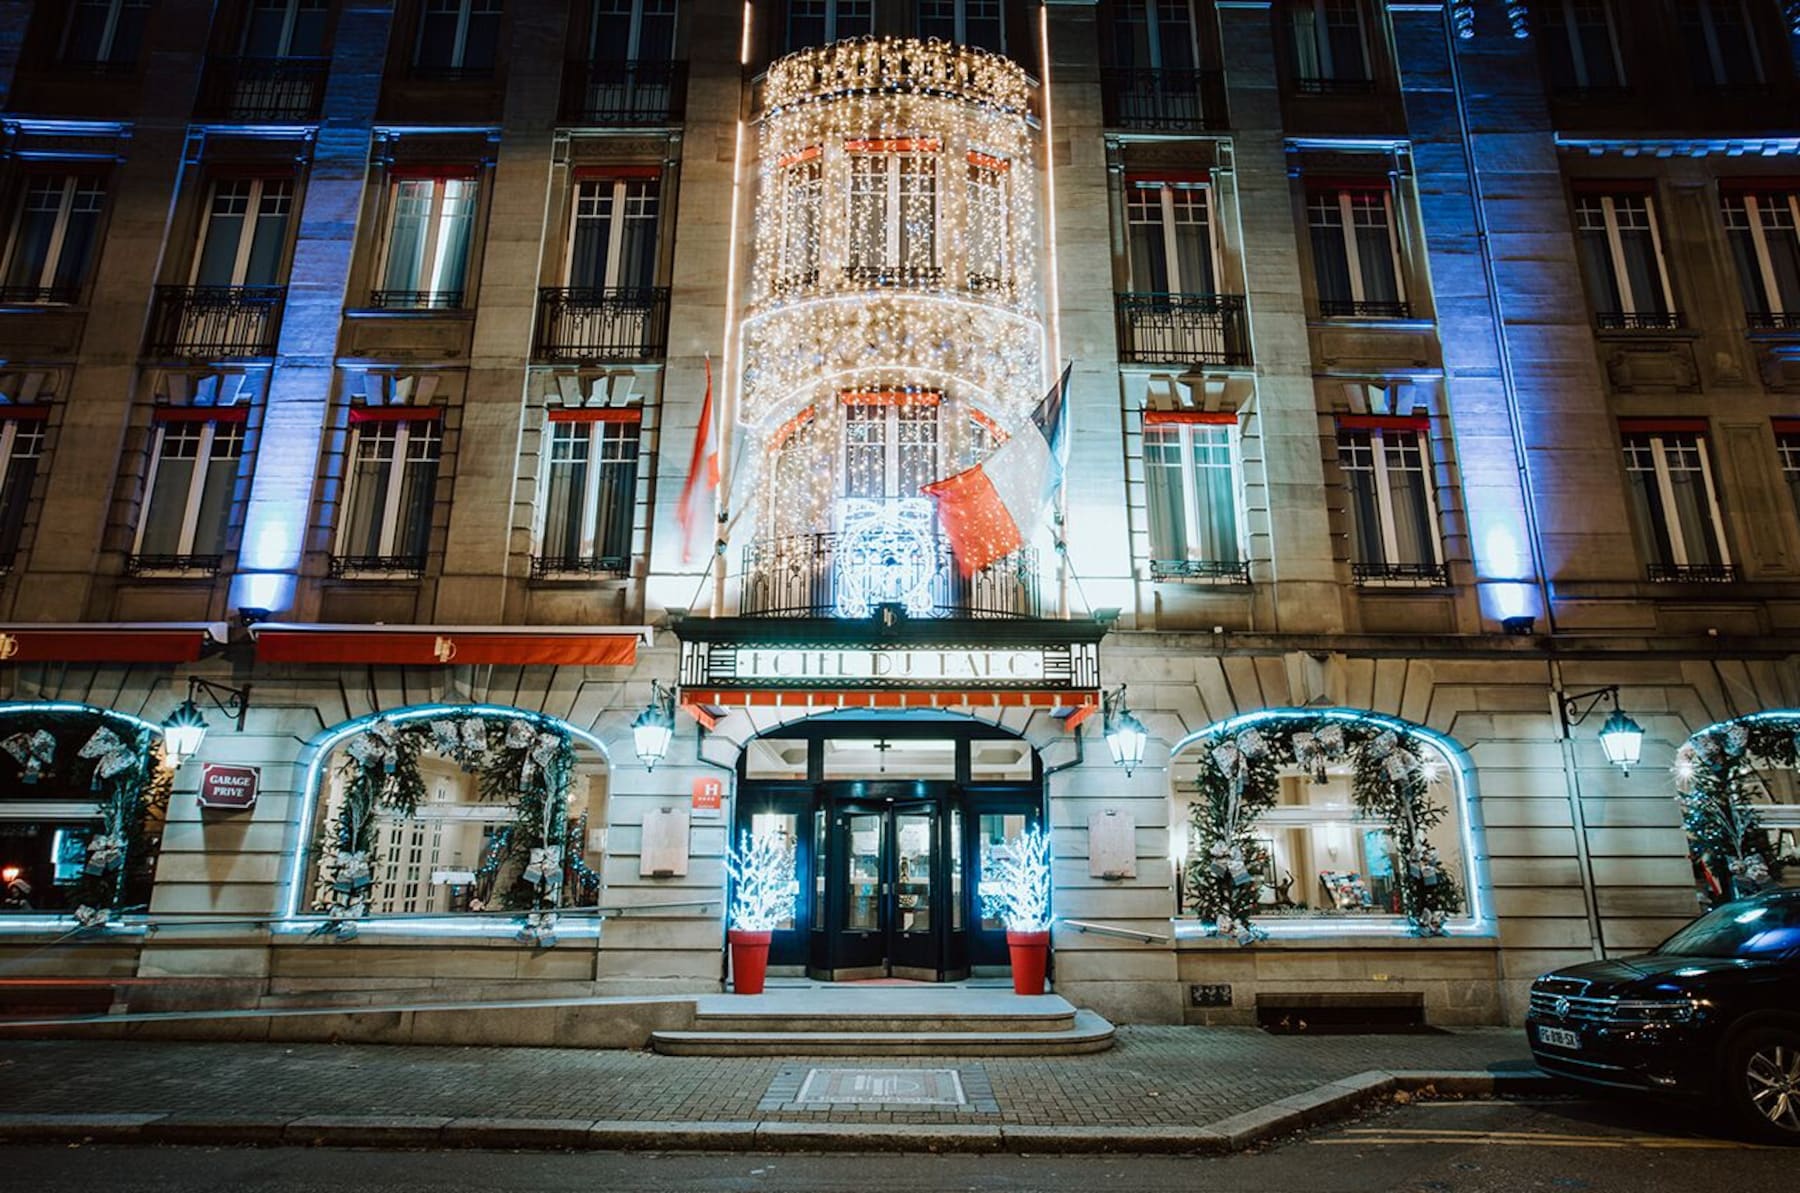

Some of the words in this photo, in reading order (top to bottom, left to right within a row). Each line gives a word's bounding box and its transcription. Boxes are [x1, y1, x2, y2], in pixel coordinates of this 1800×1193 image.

[869, 652, 913, 677] DU
[209, 774, 251, 787] GARAGE
[705, 783, 719, 796] H
